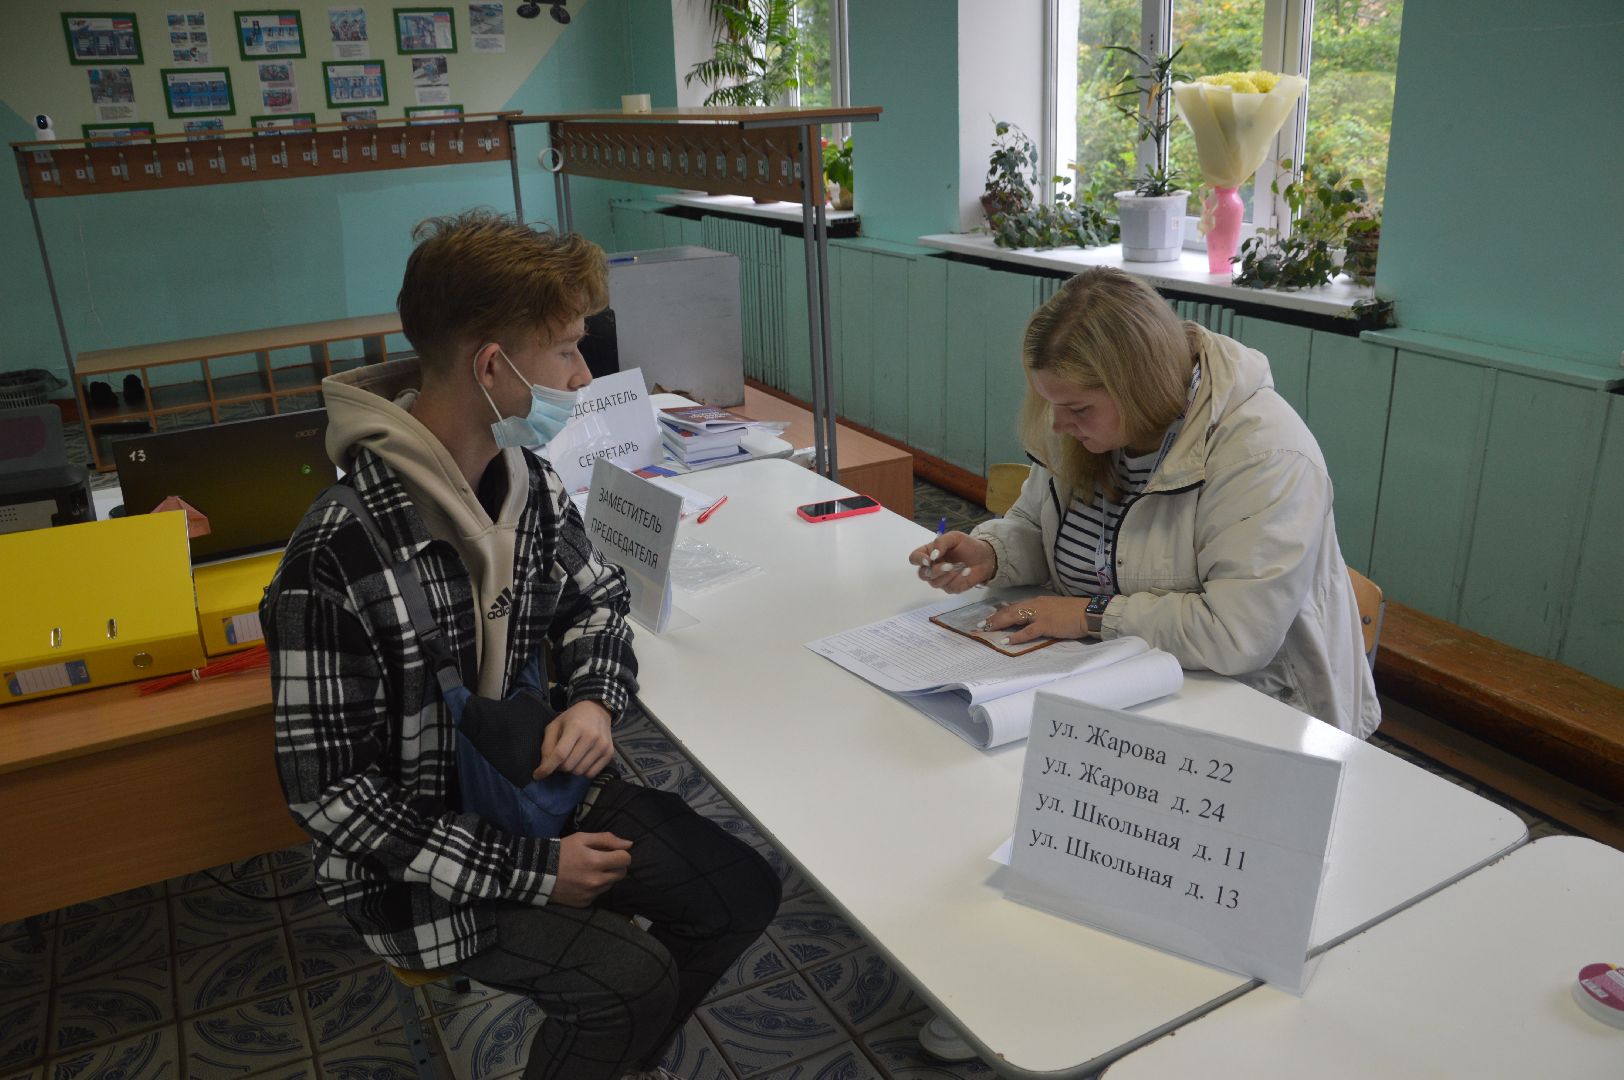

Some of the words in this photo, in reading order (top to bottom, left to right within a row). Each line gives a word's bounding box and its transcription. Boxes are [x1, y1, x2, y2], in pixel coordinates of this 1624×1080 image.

[569, 390, 638, 419] ДСЕДАТЕЛЬ
[129, 450, 147, 462] 13
[598, 487, 662, 533] ЗАМЕСТИТЕЛЬ
[591, 517, 659, 569] ПРЕДСЕДАТЕЛЯ
[1049, 720, 1078, 740] ул.
[1086, 725, 1166, 764] Жарова
[1178, 757, 1198, 775] д.
[1206, 759, 1234, 783] 22
[1042, 757, 1071, 777] ул.
[1079, 762, 1159, 803] Жарова
[1170, 796, 1190, 814] д.
[1198, 798, 1225, 822] 24
[1035, 793, 1064, 813] ул.
[1072, 799, 1181, 850] Школьная
[1192, 844, 1212, 862] д.
[1223, 847, 1245, 871] 11
[1029, 829, 1057, 850] ул.
[1065, 836, 1174, 888] Школьная
[1184, 882, 1204, 900] д.
[1216, 885, 1239, 909] 13
